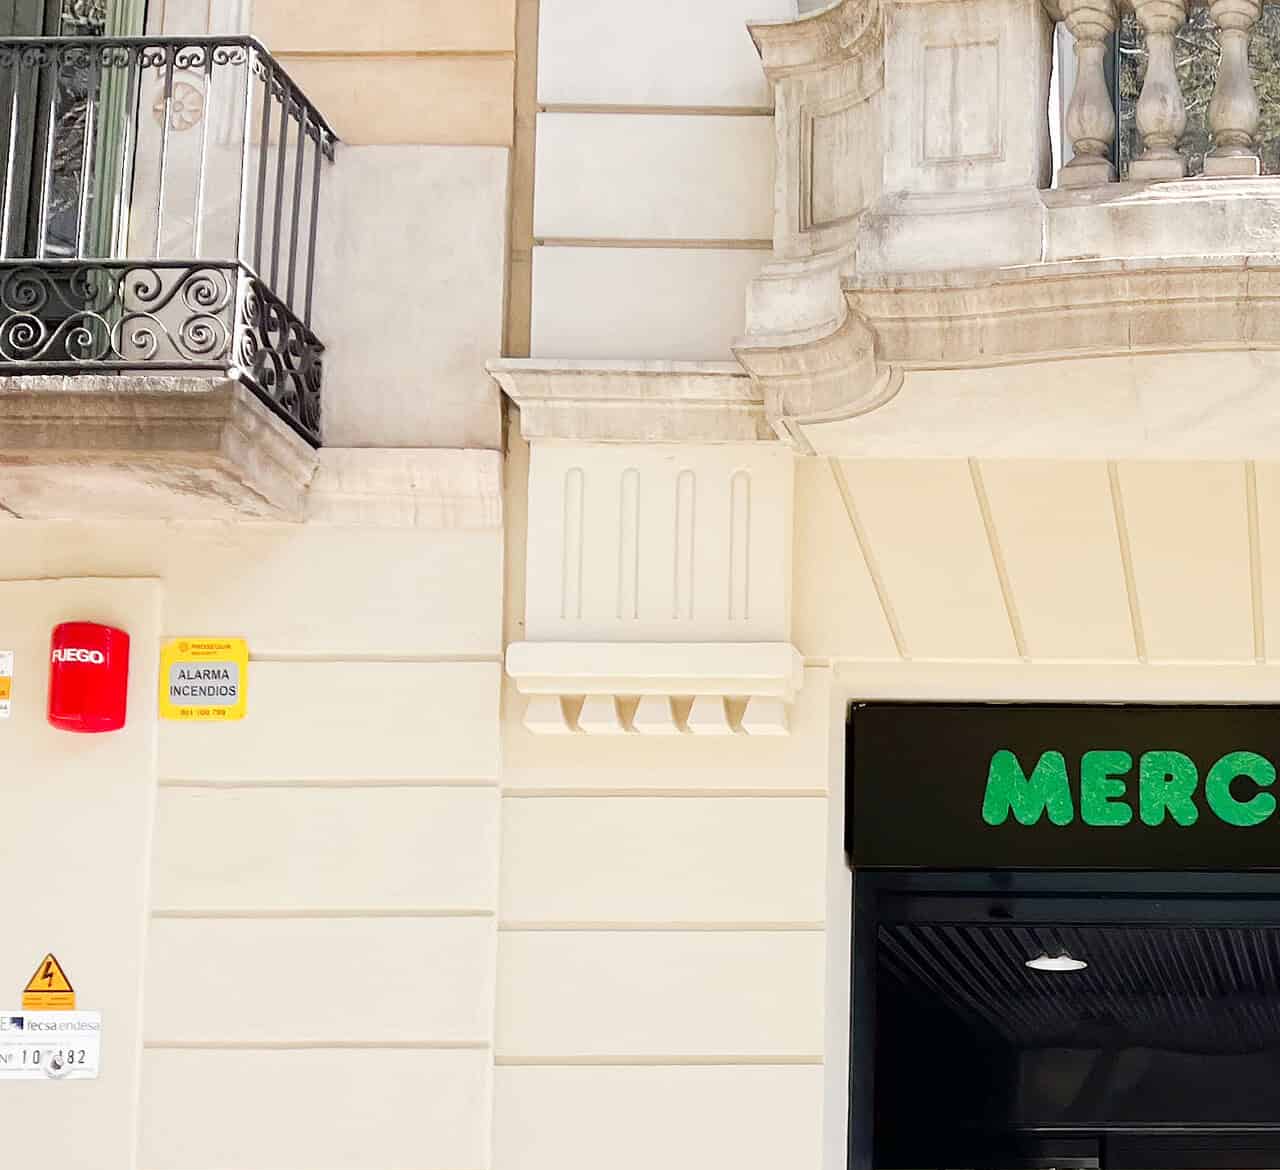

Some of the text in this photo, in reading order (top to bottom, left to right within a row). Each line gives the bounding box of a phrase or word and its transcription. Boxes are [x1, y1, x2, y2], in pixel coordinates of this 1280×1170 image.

[51, 648, 104, 664] FUEGO
[178, 669, 230, 681] ALARMA
[169, 685, 236, 697] INCENDIOS
